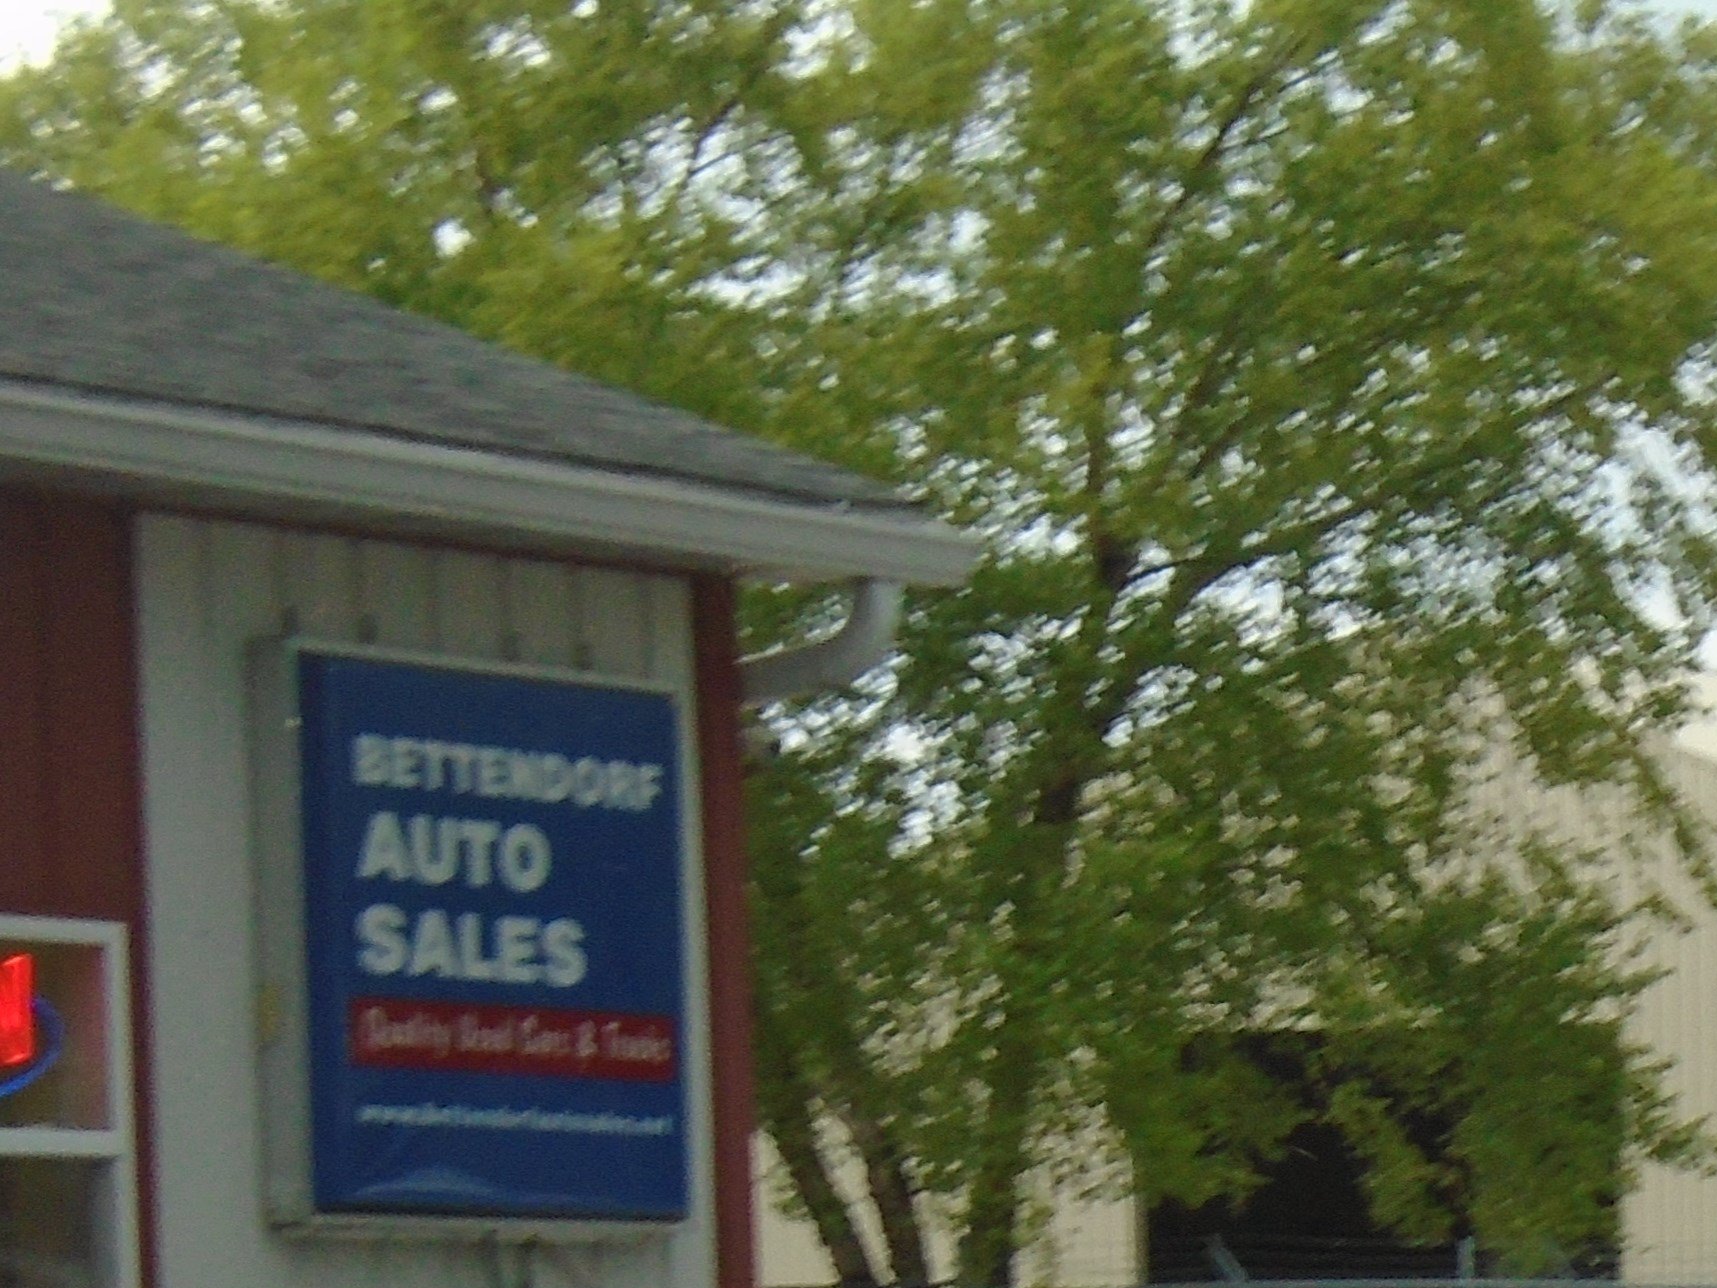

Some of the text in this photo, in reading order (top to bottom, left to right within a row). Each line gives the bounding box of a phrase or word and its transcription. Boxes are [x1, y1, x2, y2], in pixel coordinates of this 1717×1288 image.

[350, 733, 664, 812] BETTENDORF
[355, 809, 553, 893] AUTO
[355, 902, 588, 988] SALES
